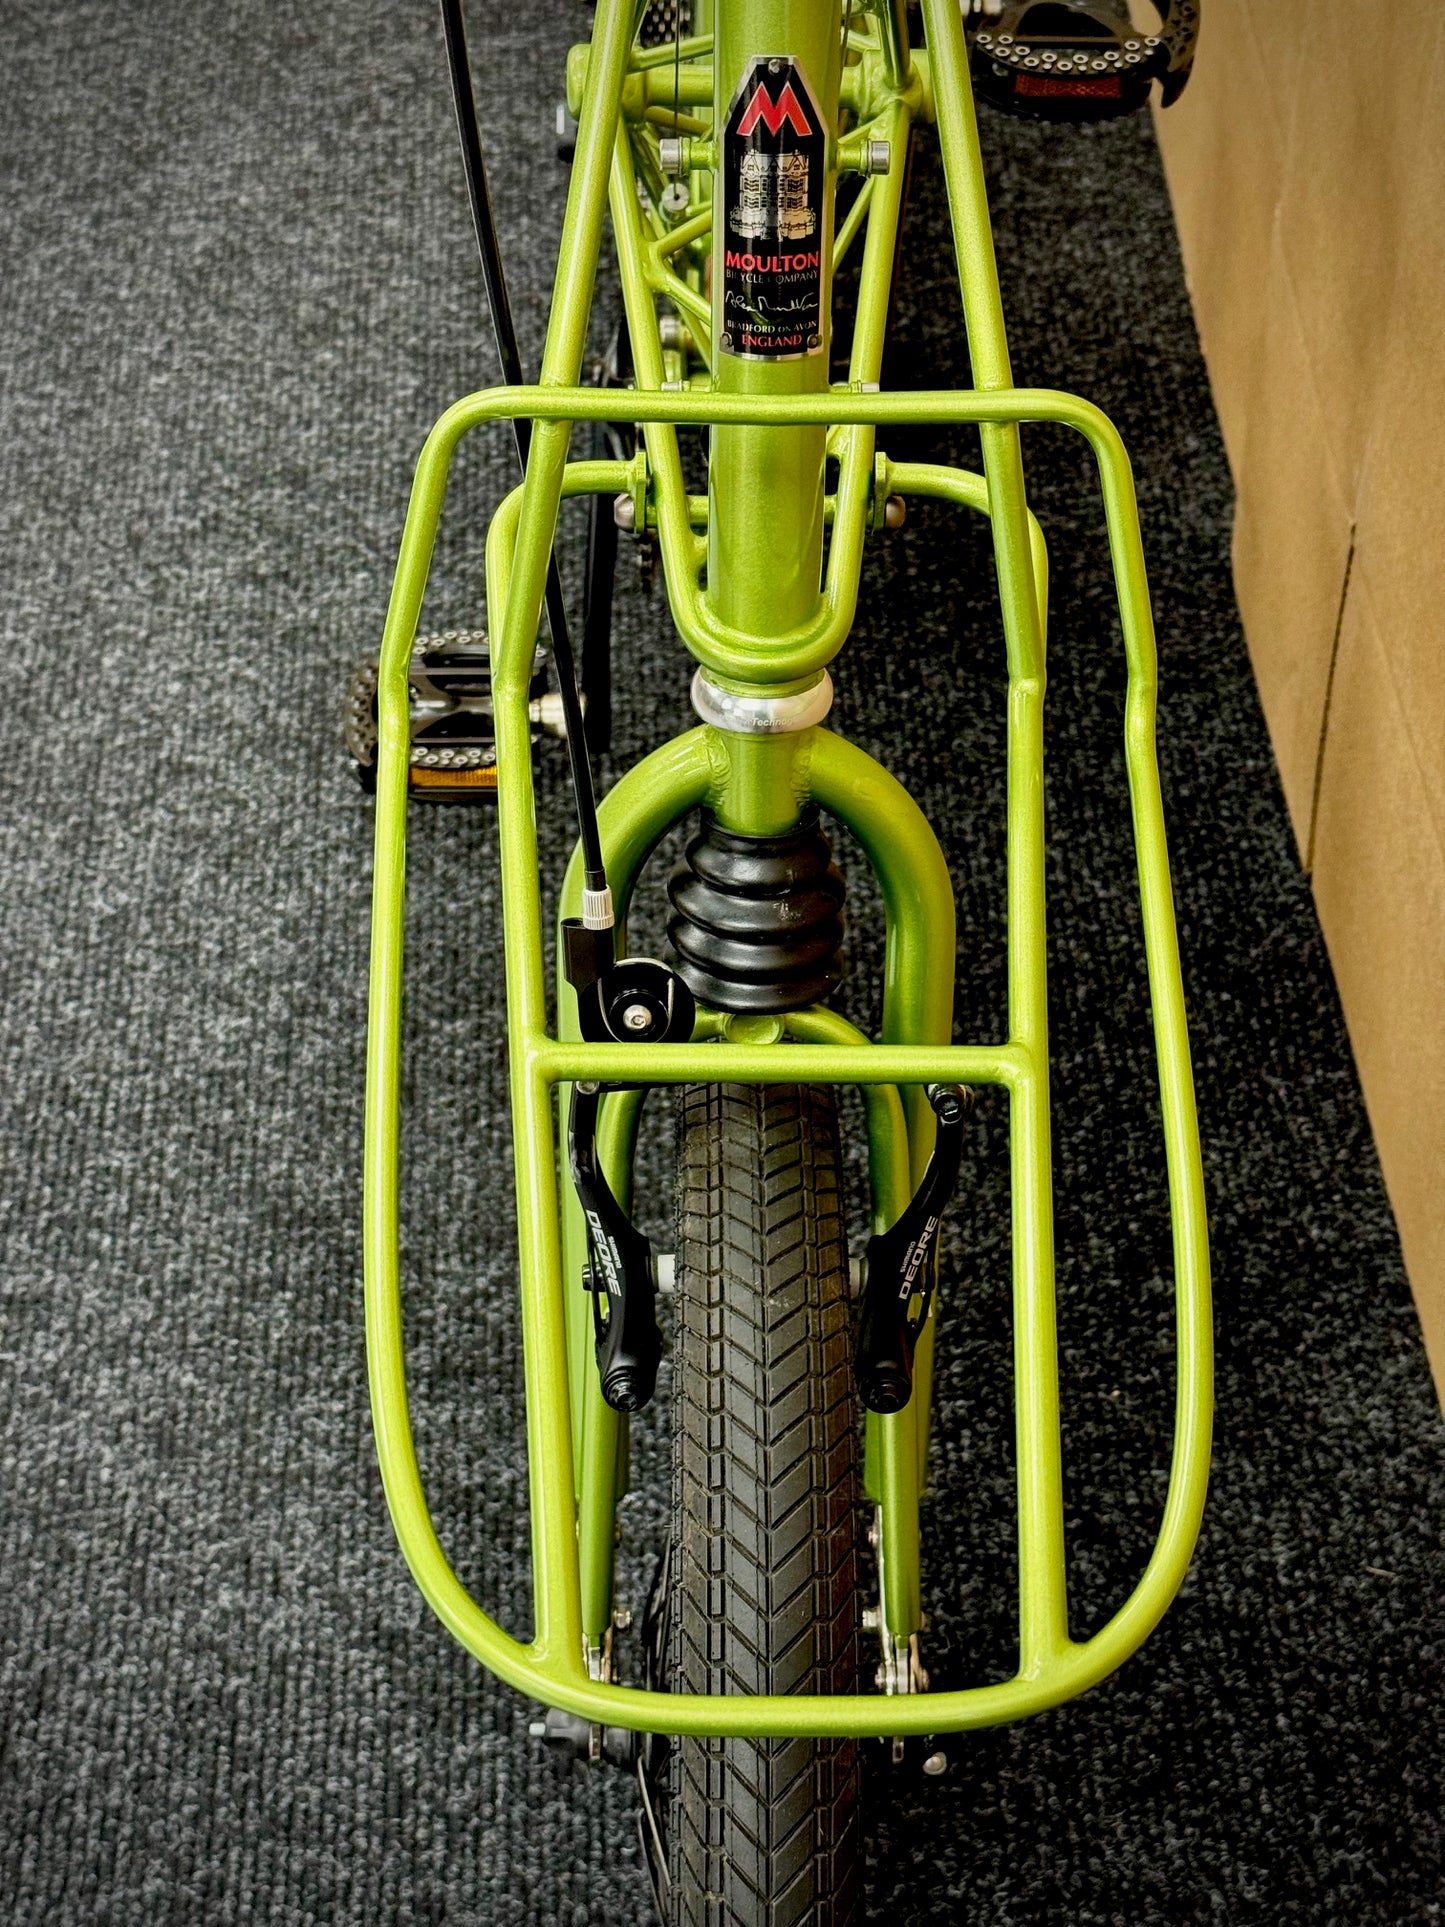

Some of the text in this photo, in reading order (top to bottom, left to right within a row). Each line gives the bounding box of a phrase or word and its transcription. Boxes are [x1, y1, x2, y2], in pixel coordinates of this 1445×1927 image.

[736, 80, 813, 137] M
[726, 250, 819, 272] MOULTON
[726, 268, 818, 284] BIYCLE OMPANY
[727, 319, 775, 333] BRADFORD
[794, 320, 817, 332] AVON
[742, 334, 802, 347] ENGLAND
[586, 1209, 622, 1297] DEORE
[898, 1215, 939, 1300] DEORE
